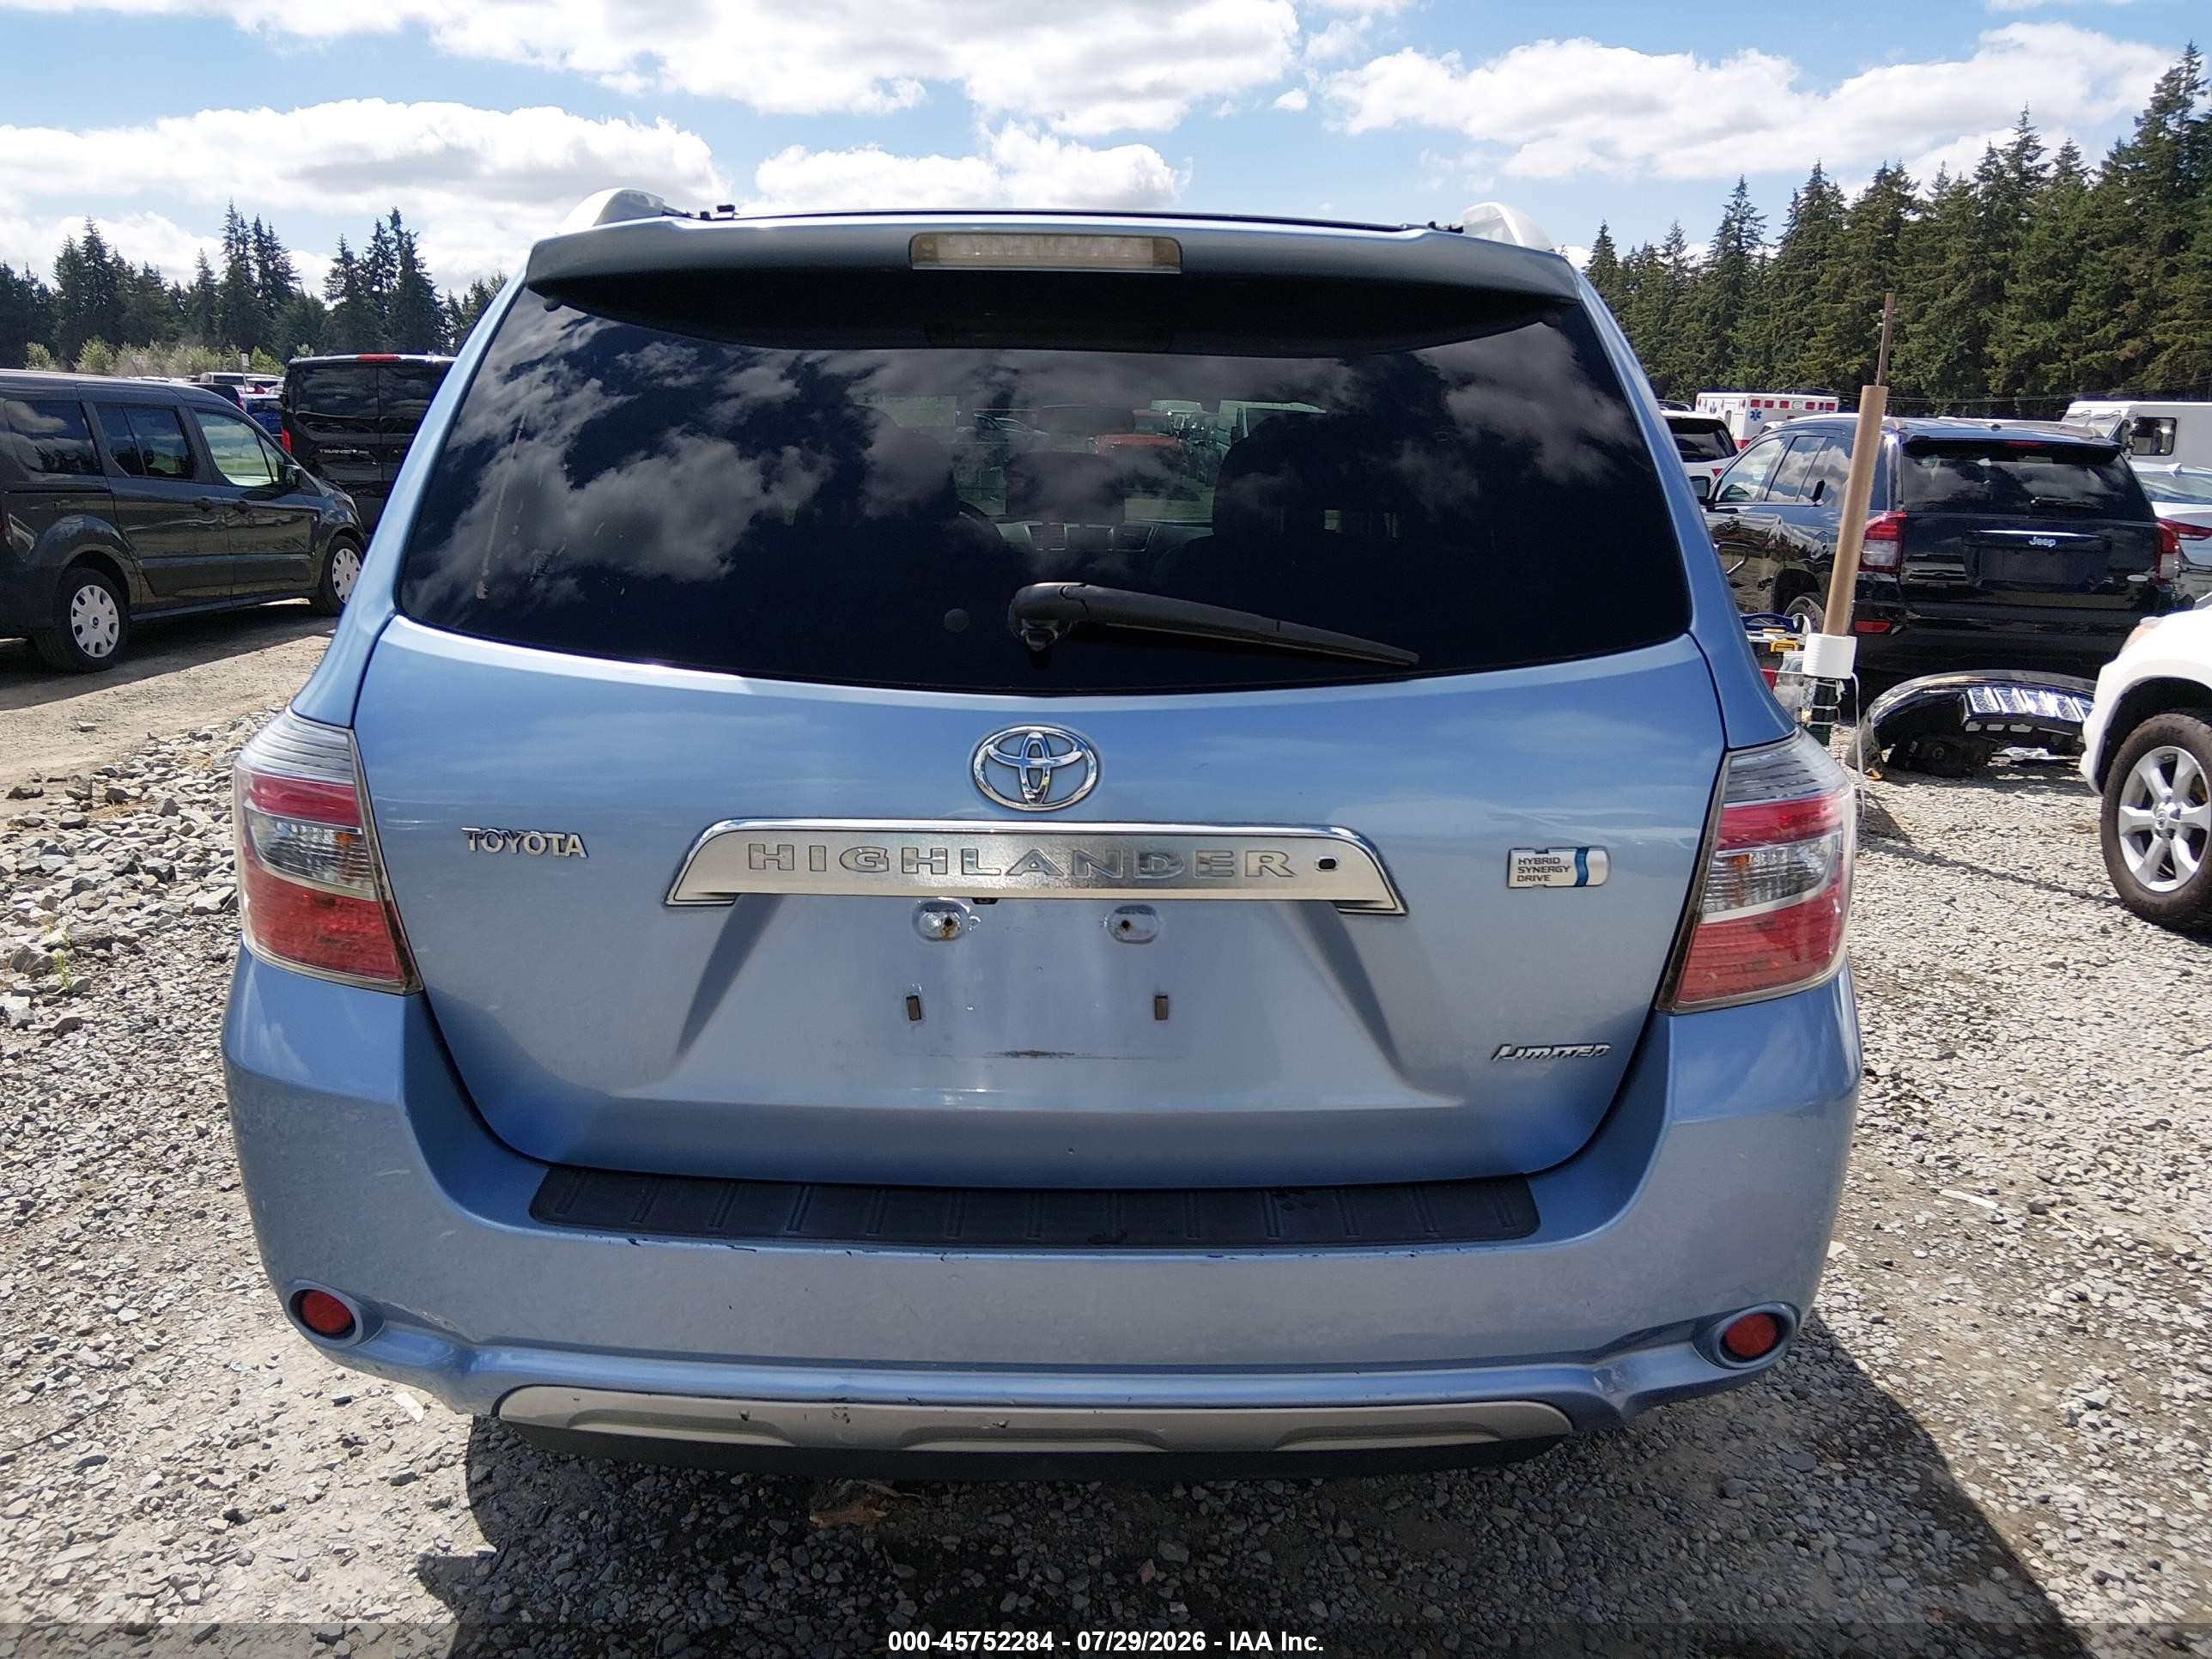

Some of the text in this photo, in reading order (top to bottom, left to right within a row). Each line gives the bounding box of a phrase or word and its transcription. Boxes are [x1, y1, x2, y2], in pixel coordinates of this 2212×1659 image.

[2028, 536, 2057, 548] Jeep
[460, 827, 589, 859] TOYOTA
[747, 842, 1297, 878] HIGHLANDER
[1517, 857, 1561, 866] HYBRID
[1517, 866, 1571, 874] SYNERGY
[1516, 874, 1552, 883] DRIVE
